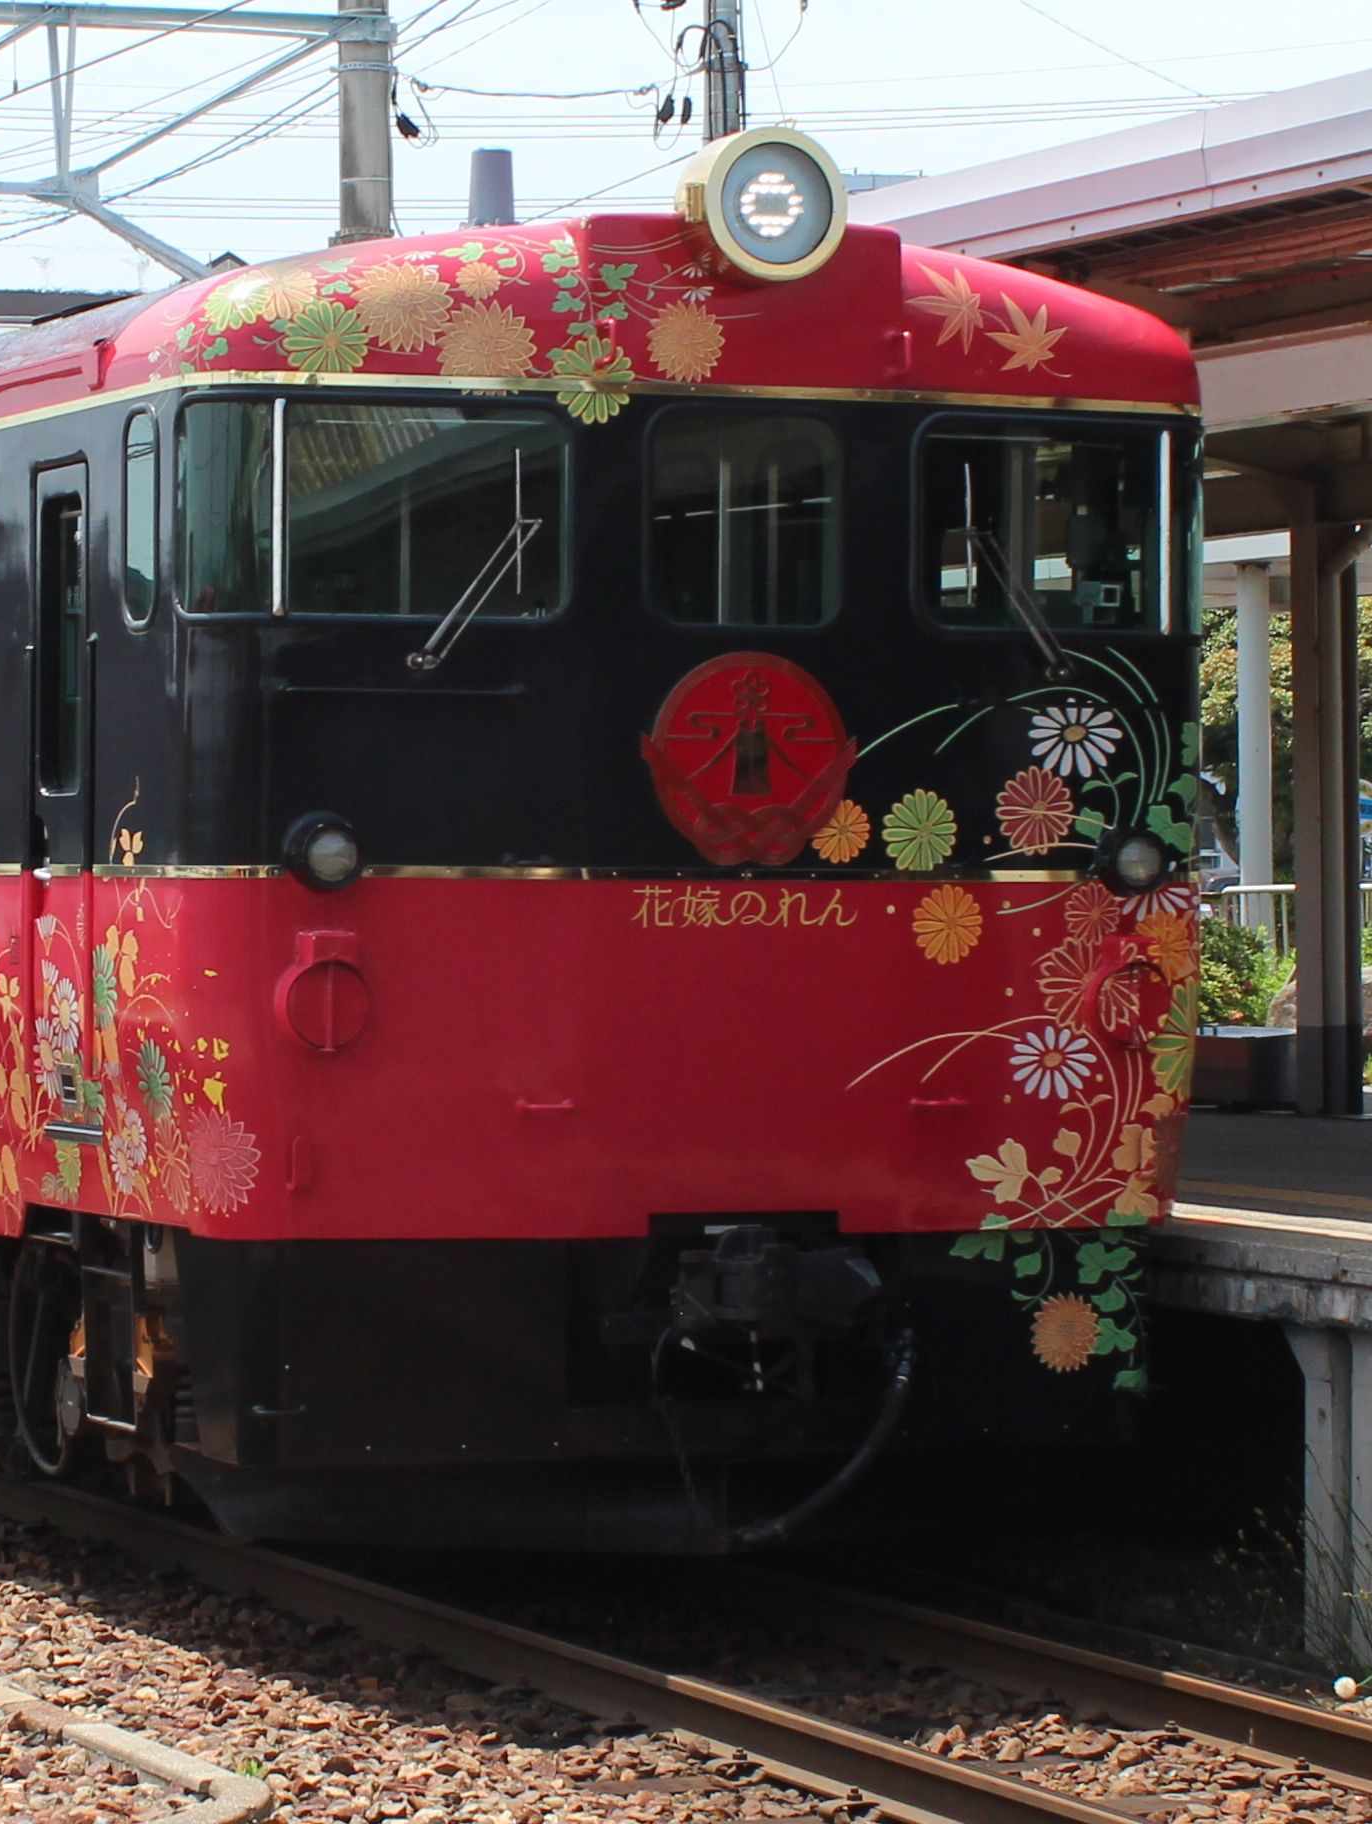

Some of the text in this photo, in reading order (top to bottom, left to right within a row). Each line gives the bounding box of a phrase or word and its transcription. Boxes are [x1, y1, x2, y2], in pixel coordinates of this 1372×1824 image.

[631, 885, 858, 928] 花嫁のれん
